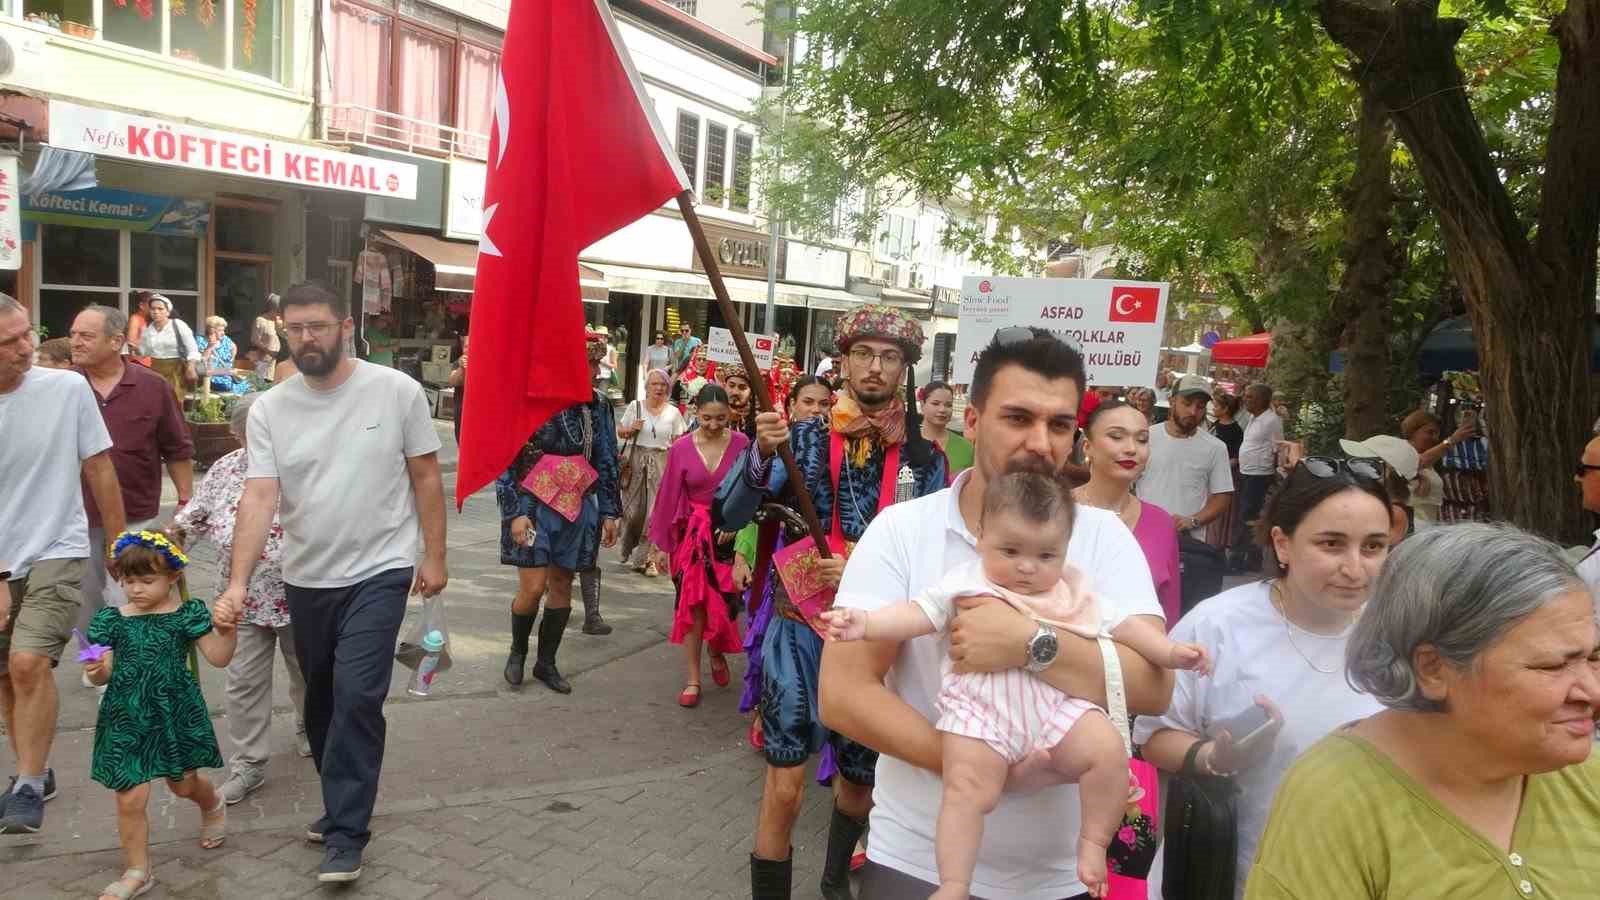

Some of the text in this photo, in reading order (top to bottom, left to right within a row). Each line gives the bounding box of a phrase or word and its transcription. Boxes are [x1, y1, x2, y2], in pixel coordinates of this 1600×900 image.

[83, 127, 125, 149] Nefis
[127, 123, 272, 175] KÖFTECİ
[284, 152, 381, 191] KEMAL
[88, 200, 133, 216] Kemal
[1040, 306, 1084, 319] ASFAD
[1066, 329, 1125, 343] FOLKLAR
[1088, 350, 1141, 367] KULÜBÜ
